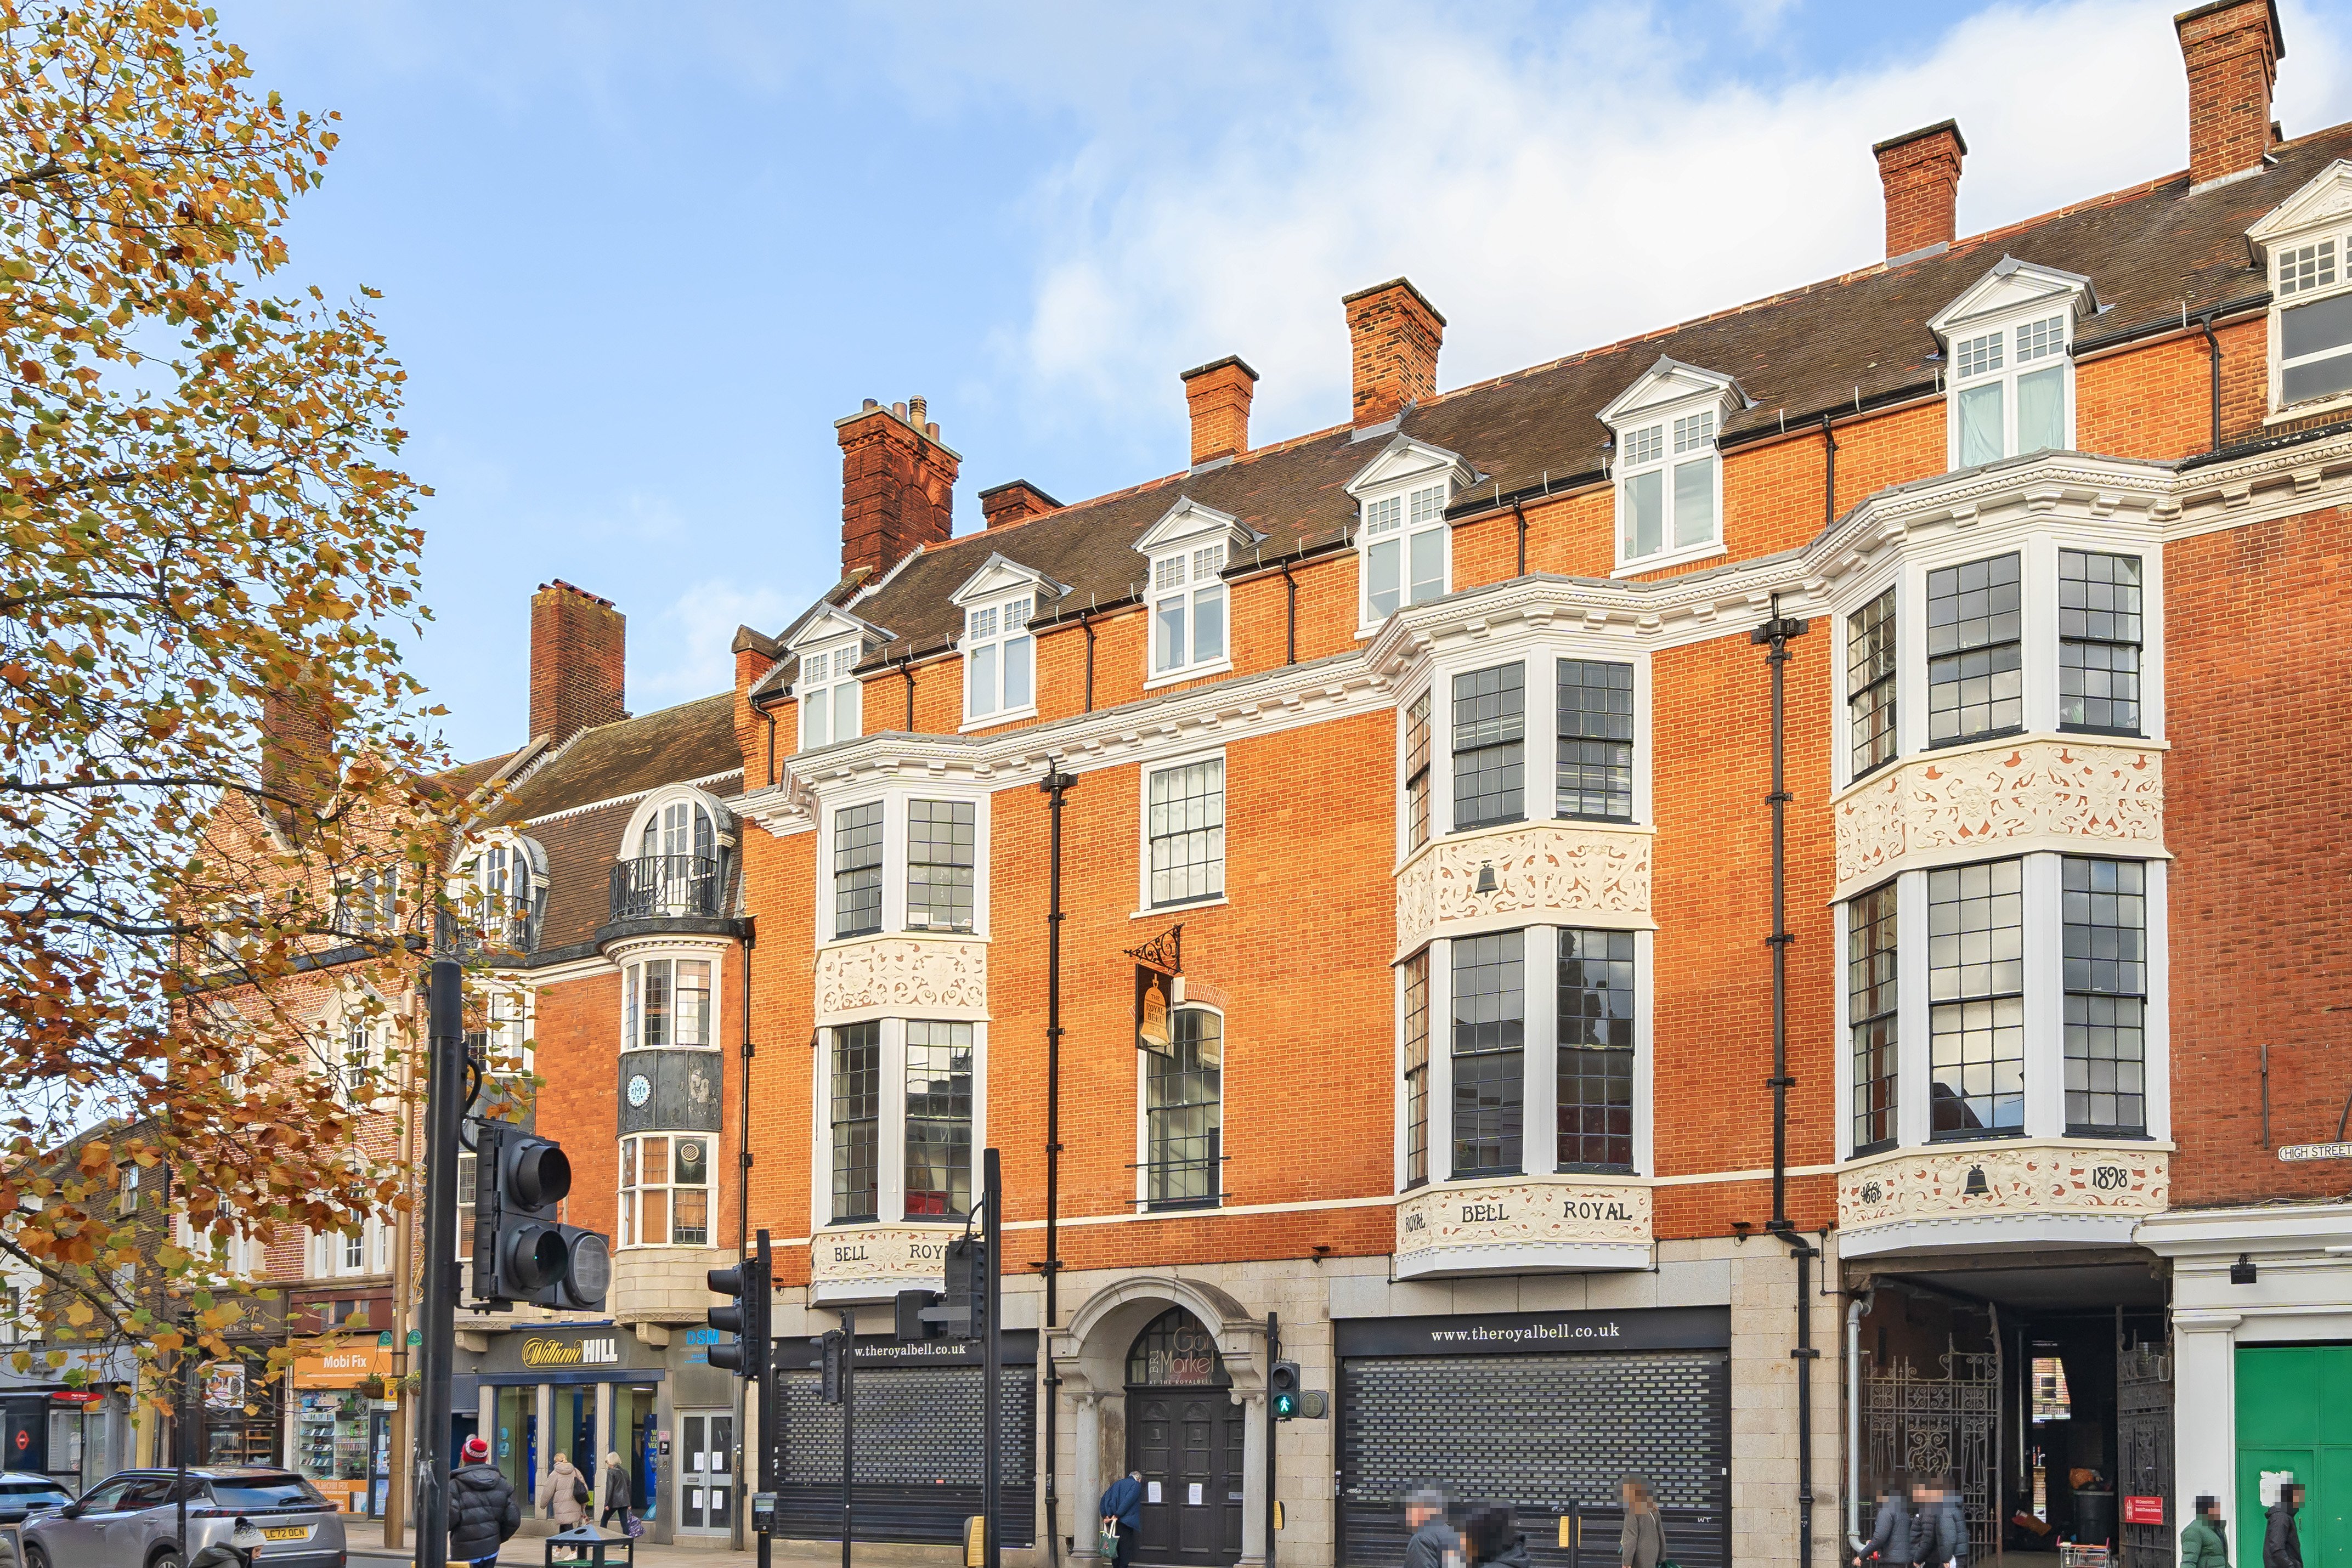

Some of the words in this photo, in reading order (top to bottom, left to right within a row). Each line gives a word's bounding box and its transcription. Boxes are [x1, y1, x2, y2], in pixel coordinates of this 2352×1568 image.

[1146, 1003, 1164, 1016] ROYAL
[1148, 1012, 1163, 1024] BELL
[2285, 1147, 2308, 1158] HIGH
[2311, 1145, 2352, 1156] STREET
[2092, 1166, 2128, 1190] 1898
[1461, 1204, 1510, 1222] BELL
[1563, 1201, 1633, 1220] ROYAL
[1405, 1213, 1426, 1233] ROYAL
[834, 1246, 869, 1261] BELL
[909, 1244, 948, 1260] ROY
[686, 1329, 720, 1345] DSM
[1431, 1322, 1620, 1342] www.theroyalbell.co.uk
[522, 1338, 583, 1366] William
[583, 1338, 619, 1363] HILL
[843, 1343, 966, 1358] w.theroyalbell.co.uk
[323, 1355, 350, 1369] Mobi
[352, 1354, 368, 1368] Fix
[1161, 1350, 1214, 1374] Market
[264, 1530, 287, 1538] LC72
